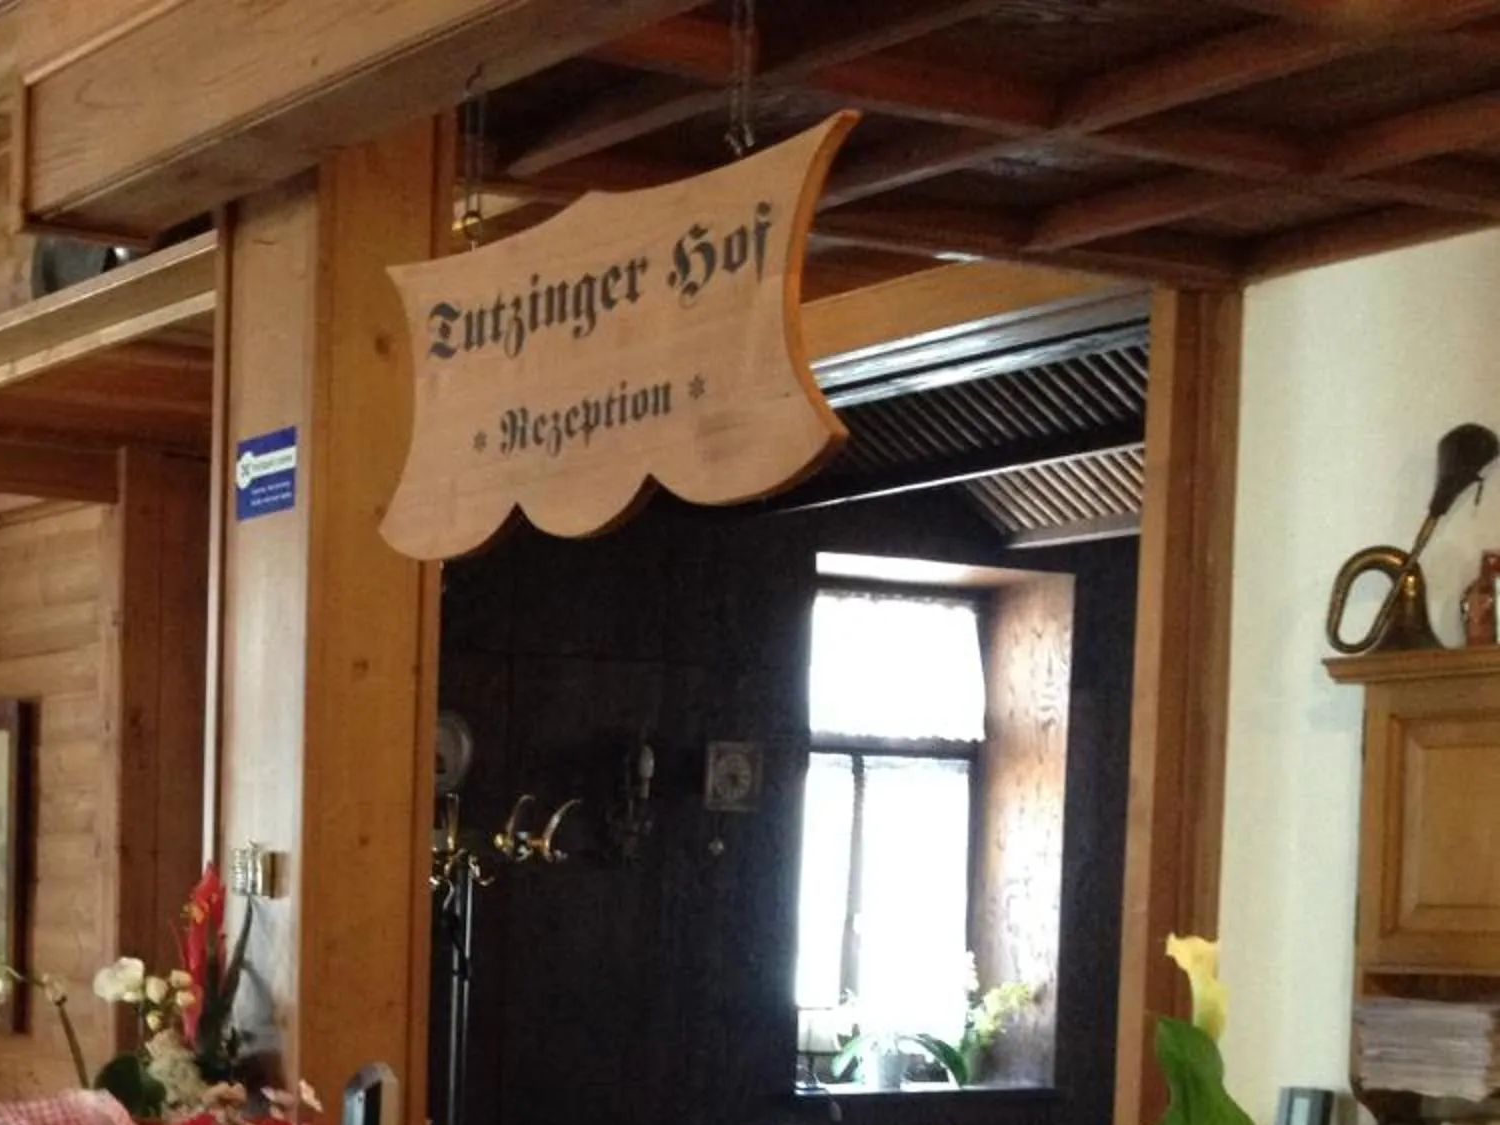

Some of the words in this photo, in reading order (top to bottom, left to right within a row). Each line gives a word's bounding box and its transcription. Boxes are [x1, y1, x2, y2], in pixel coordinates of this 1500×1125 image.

[427, 256, 649, 360] Tutzinger
[667, 201, 773, 301] Hof
[499, 379, 673, 457] Rezeption
